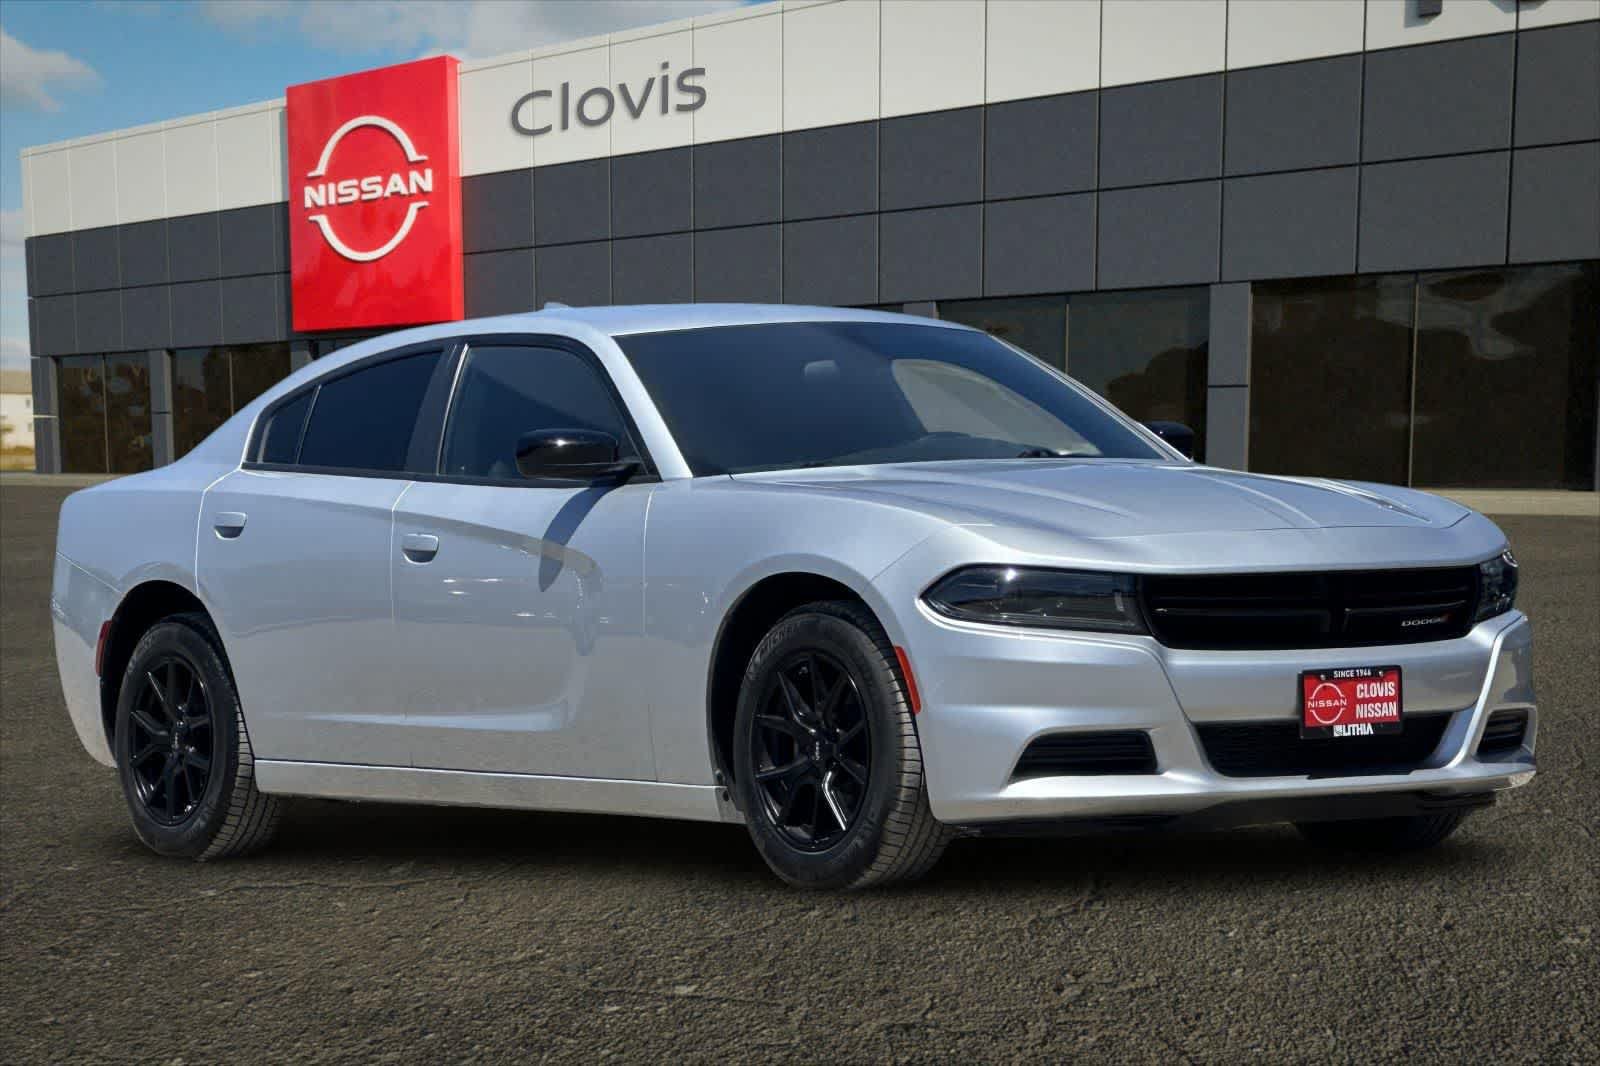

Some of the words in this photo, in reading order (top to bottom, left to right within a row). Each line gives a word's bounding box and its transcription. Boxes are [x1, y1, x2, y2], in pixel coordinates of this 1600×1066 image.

[512, 61, 707, 136] Clovis
[304, 168, 433, 209] NISSAN
[1401, 618, 1441, 627] DOD
[1333, 670, 1354, 678] SINCE
[1356, 681, 1395, 699] CLOVIS
[1307, 698, 1348, 709] NISSAN
[1355, 701, 1397, 719] NISSAN
[1342, 723, 1374, 736] LITHIA
